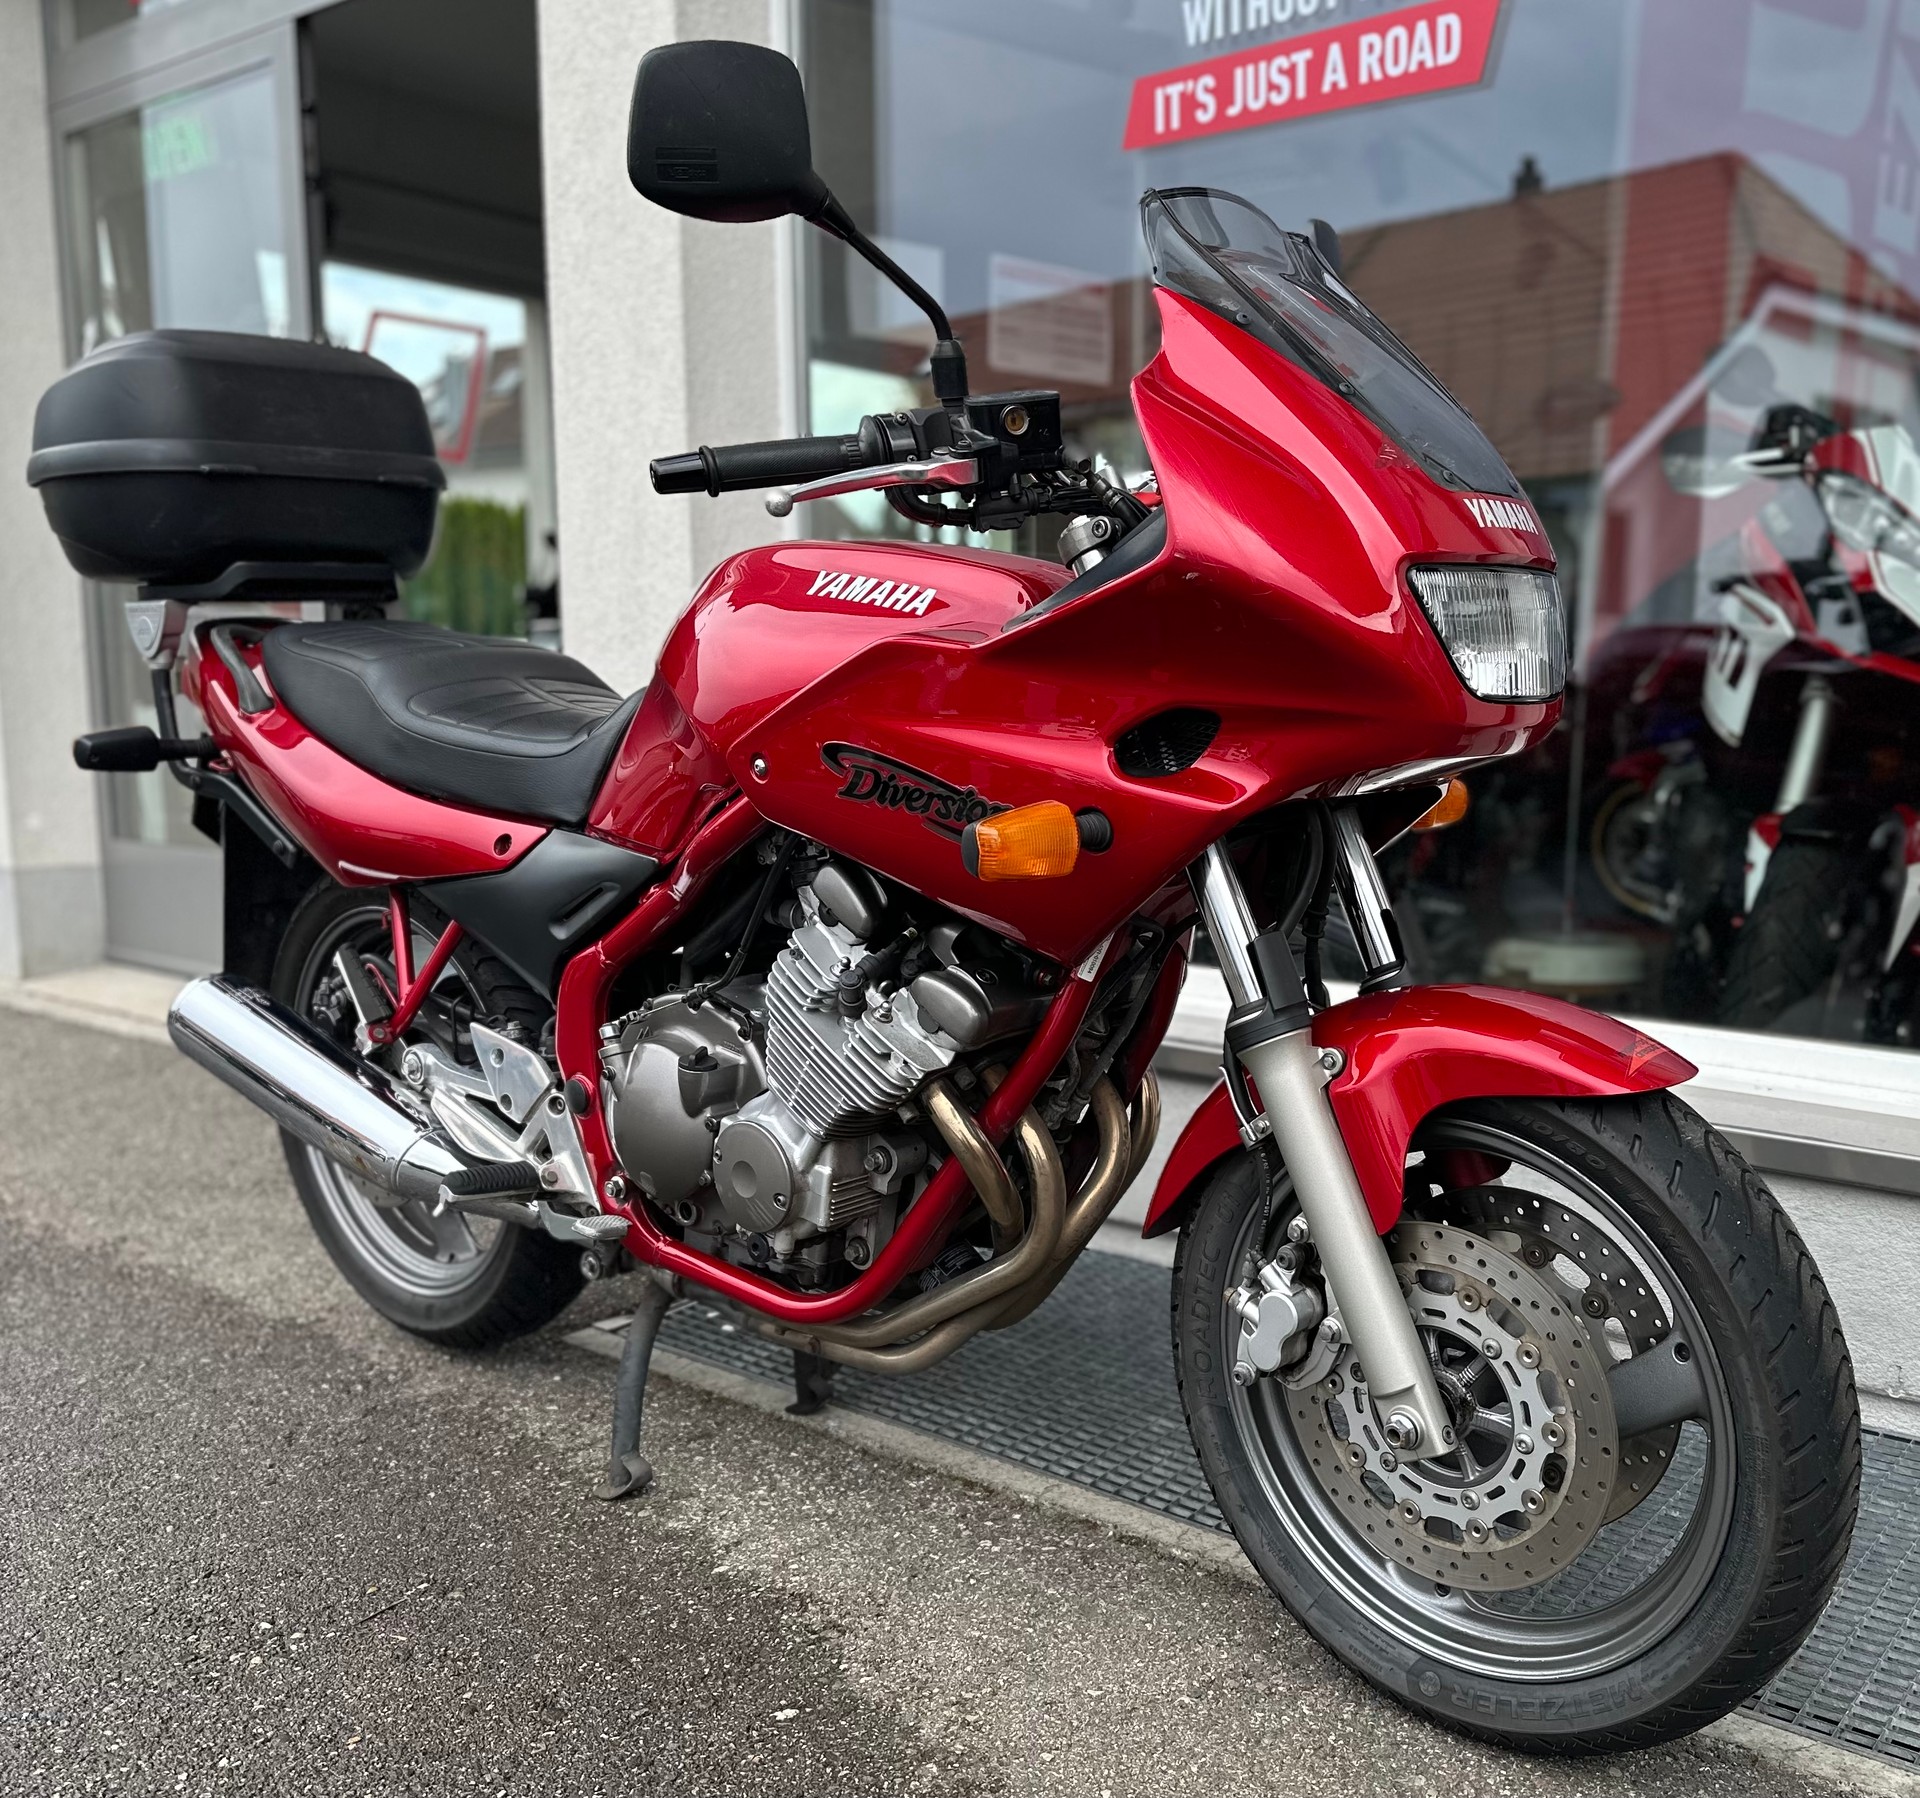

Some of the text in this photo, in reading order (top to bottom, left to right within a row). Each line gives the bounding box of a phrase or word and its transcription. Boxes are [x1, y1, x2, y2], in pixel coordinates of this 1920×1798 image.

[1154, 12, 1462, 134] IT'S JUST A ROAD
[1463, 498, 1539, 535] YAMAHA
[806, 569, 938, 616] YAMAHA
[1451, 1676, 1643, 1721] METZELER
